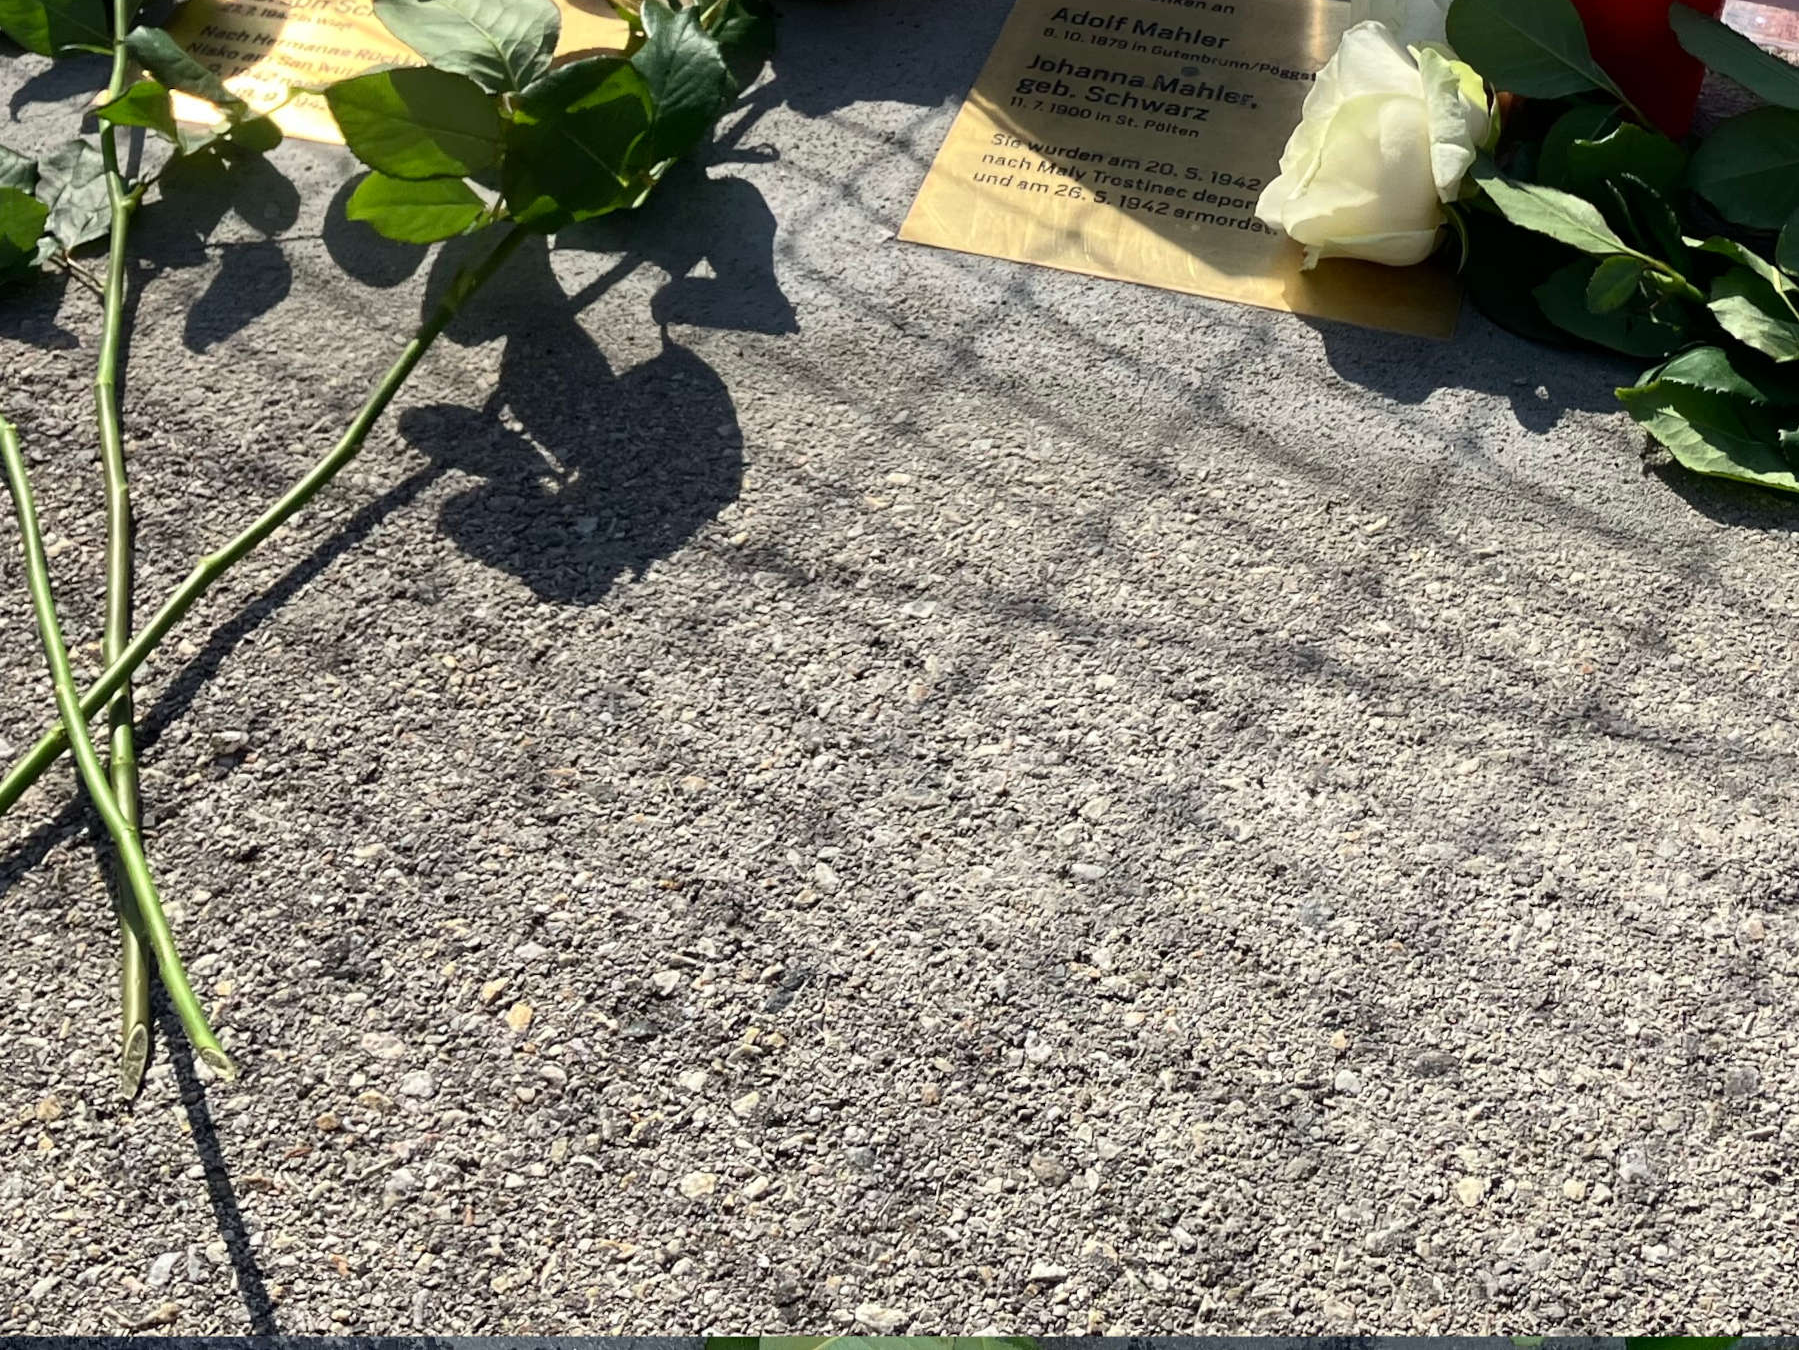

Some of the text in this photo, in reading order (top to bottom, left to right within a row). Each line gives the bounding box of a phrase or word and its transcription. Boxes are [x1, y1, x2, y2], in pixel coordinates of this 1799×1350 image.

[1050, 7, 1231, 50] Adolf Mahler
[1212, 2, 1236, 15] an
[200, 25, 250, 43] Nach
[1063, 30, 1085, 44] 10.
[1090, 35, 1128, 50] 1879
[1131, 41, 1147, 54] in
[1015, 77, 1210, 122] geb. Schwarz
[1027, 54, 1258, 110] Johanna Mahler,
[1009, 96, 1200, 139] 11. 7. 1900 in St. Pölten
[982, 151, 1258, 210] nach Maly Trostinec depor
[990, 133, 1262, 192] Sie wurden am 20. 5. 1942
[972, 170, 1011, 188] und
[1016, 180, 1049, 195] am
[1054, 183, 1087, 201] 26.
[1093, 190, 1112, 205] 5.
[1118, 195, 1170, 217] 1942
